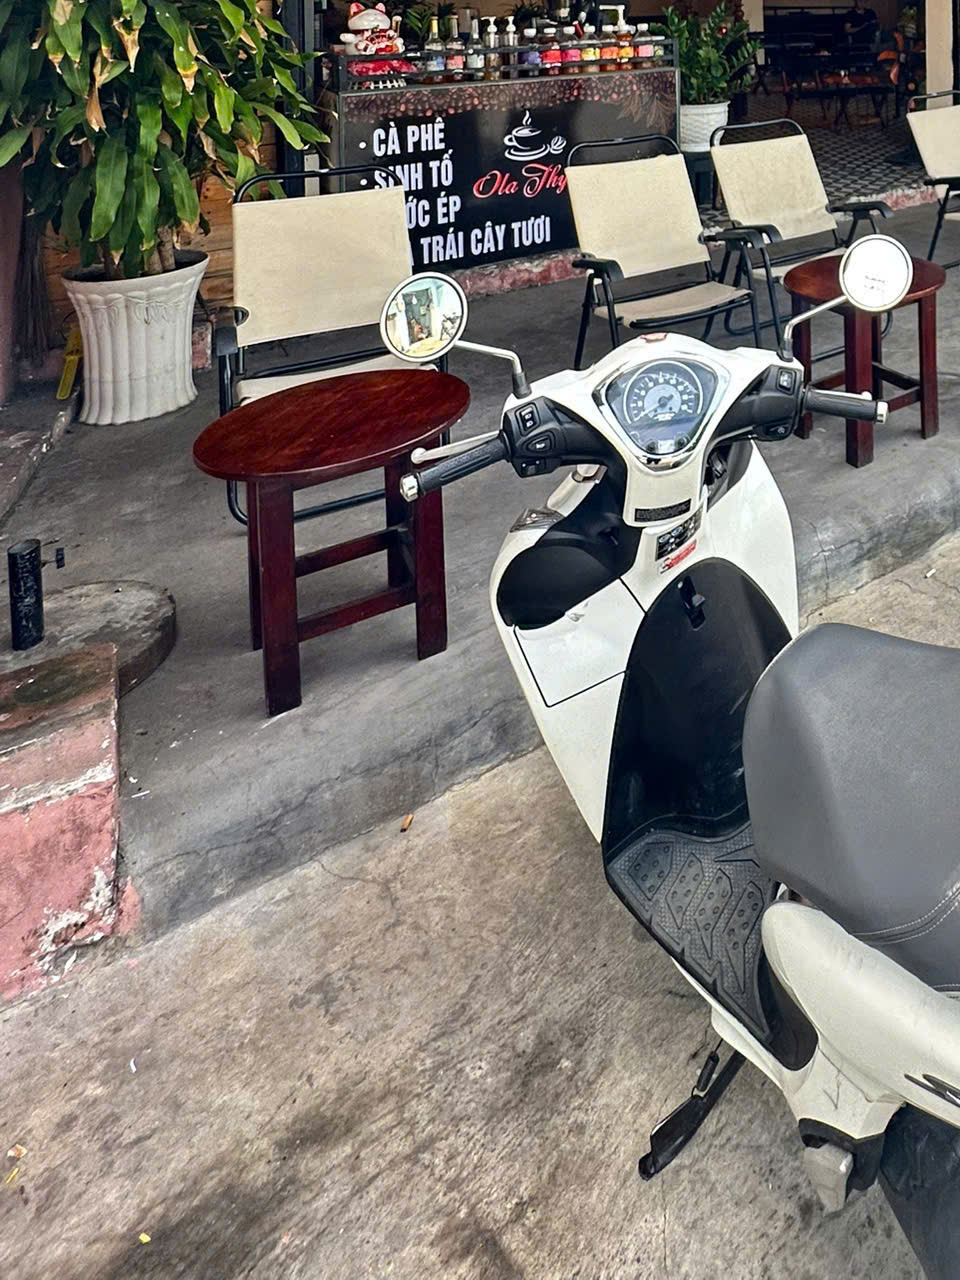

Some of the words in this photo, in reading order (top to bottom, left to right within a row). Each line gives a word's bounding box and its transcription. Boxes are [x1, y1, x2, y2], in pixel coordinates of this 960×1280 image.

[373, 121, 401, 157] CÀ
[407, 117, 446, 153] PHÊ
[429, 149, 453, 187] TỐ
[473, 169, 518, 198] Ola
[406, 195, 430, 229] ỚC
[437, 191, 462, 225] ÉP
[420, 227, 464, 264] TRÁI
[470, 221, 506, 256] CÂY
[511, 214, 551, 248] TƯƠI
